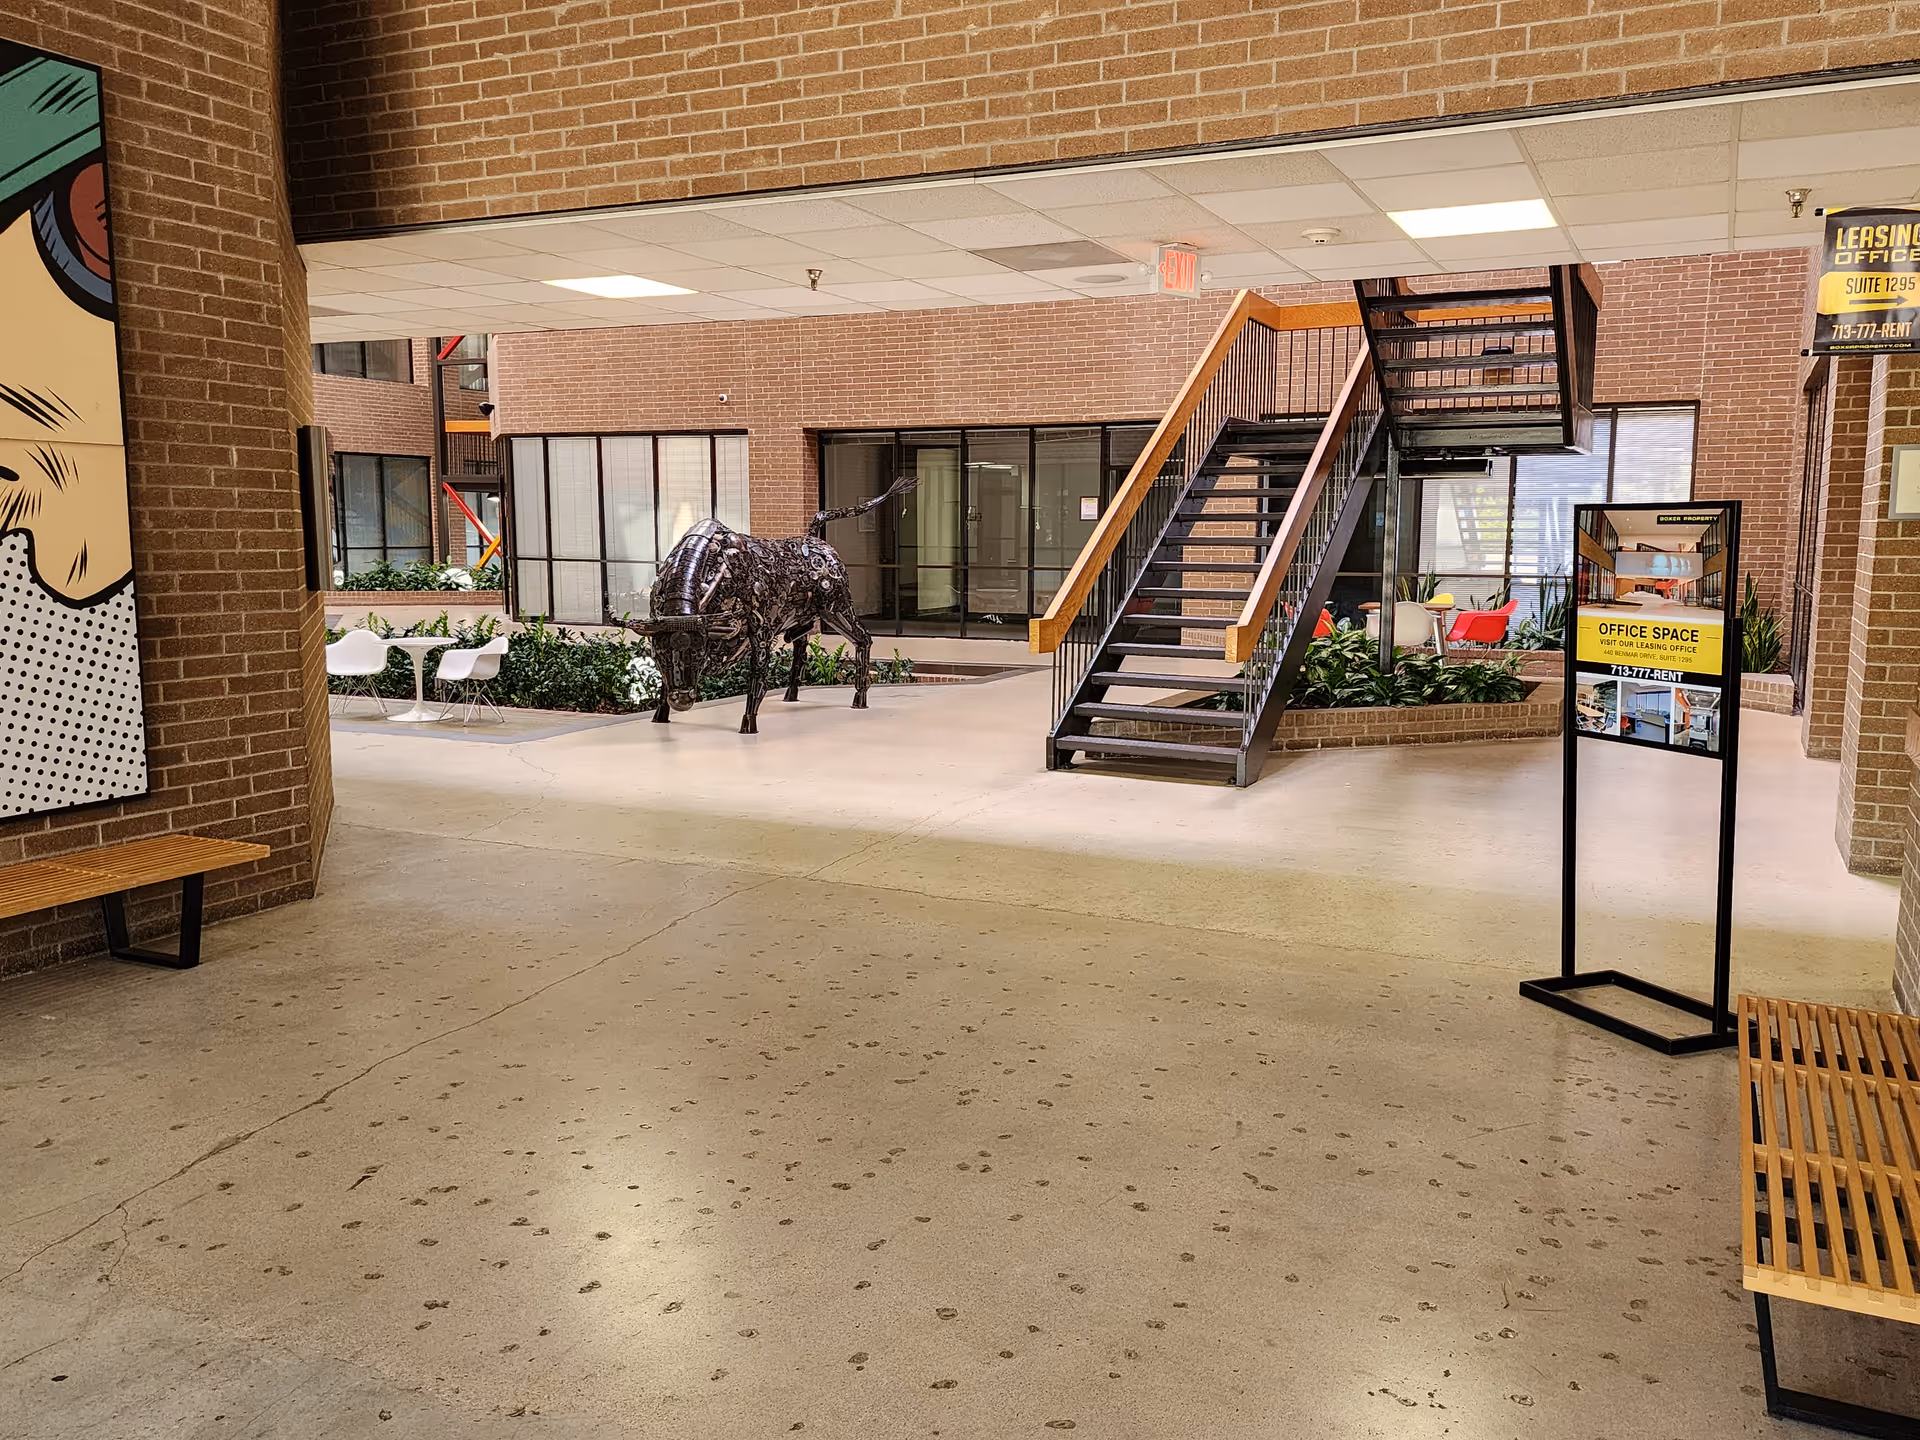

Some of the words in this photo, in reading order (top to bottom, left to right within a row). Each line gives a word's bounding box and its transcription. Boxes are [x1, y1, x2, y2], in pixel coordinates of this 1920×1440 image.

[1834, 249, 1920, 265] OFFICE
[1165, 250, 1196, 292] EXIT
[1846, 277, 1881, 294] SUITE
[1885, 277, 1916, 292] 1295
[1832, 322, 1912, 339] 713-777-RENT
[1599, 622, 1648, 638] OFFICE
[1652, 626, 1699, 643] SPACE
[1600, 638, 1617, 646] VISIT
[1619, 640, 1634, 648] OUR
[1636, 641, 1667, 651] LEASING
[1669, 644, 1698, 654] OFFICE
[1614, 650, 1639, 658] BENMAR
[1639, 652, 1658, 661] DRIVE,
[1659, 654, 1677, 662] SUITE
[1610, 664, 1684, 682] 713-777-RENT
